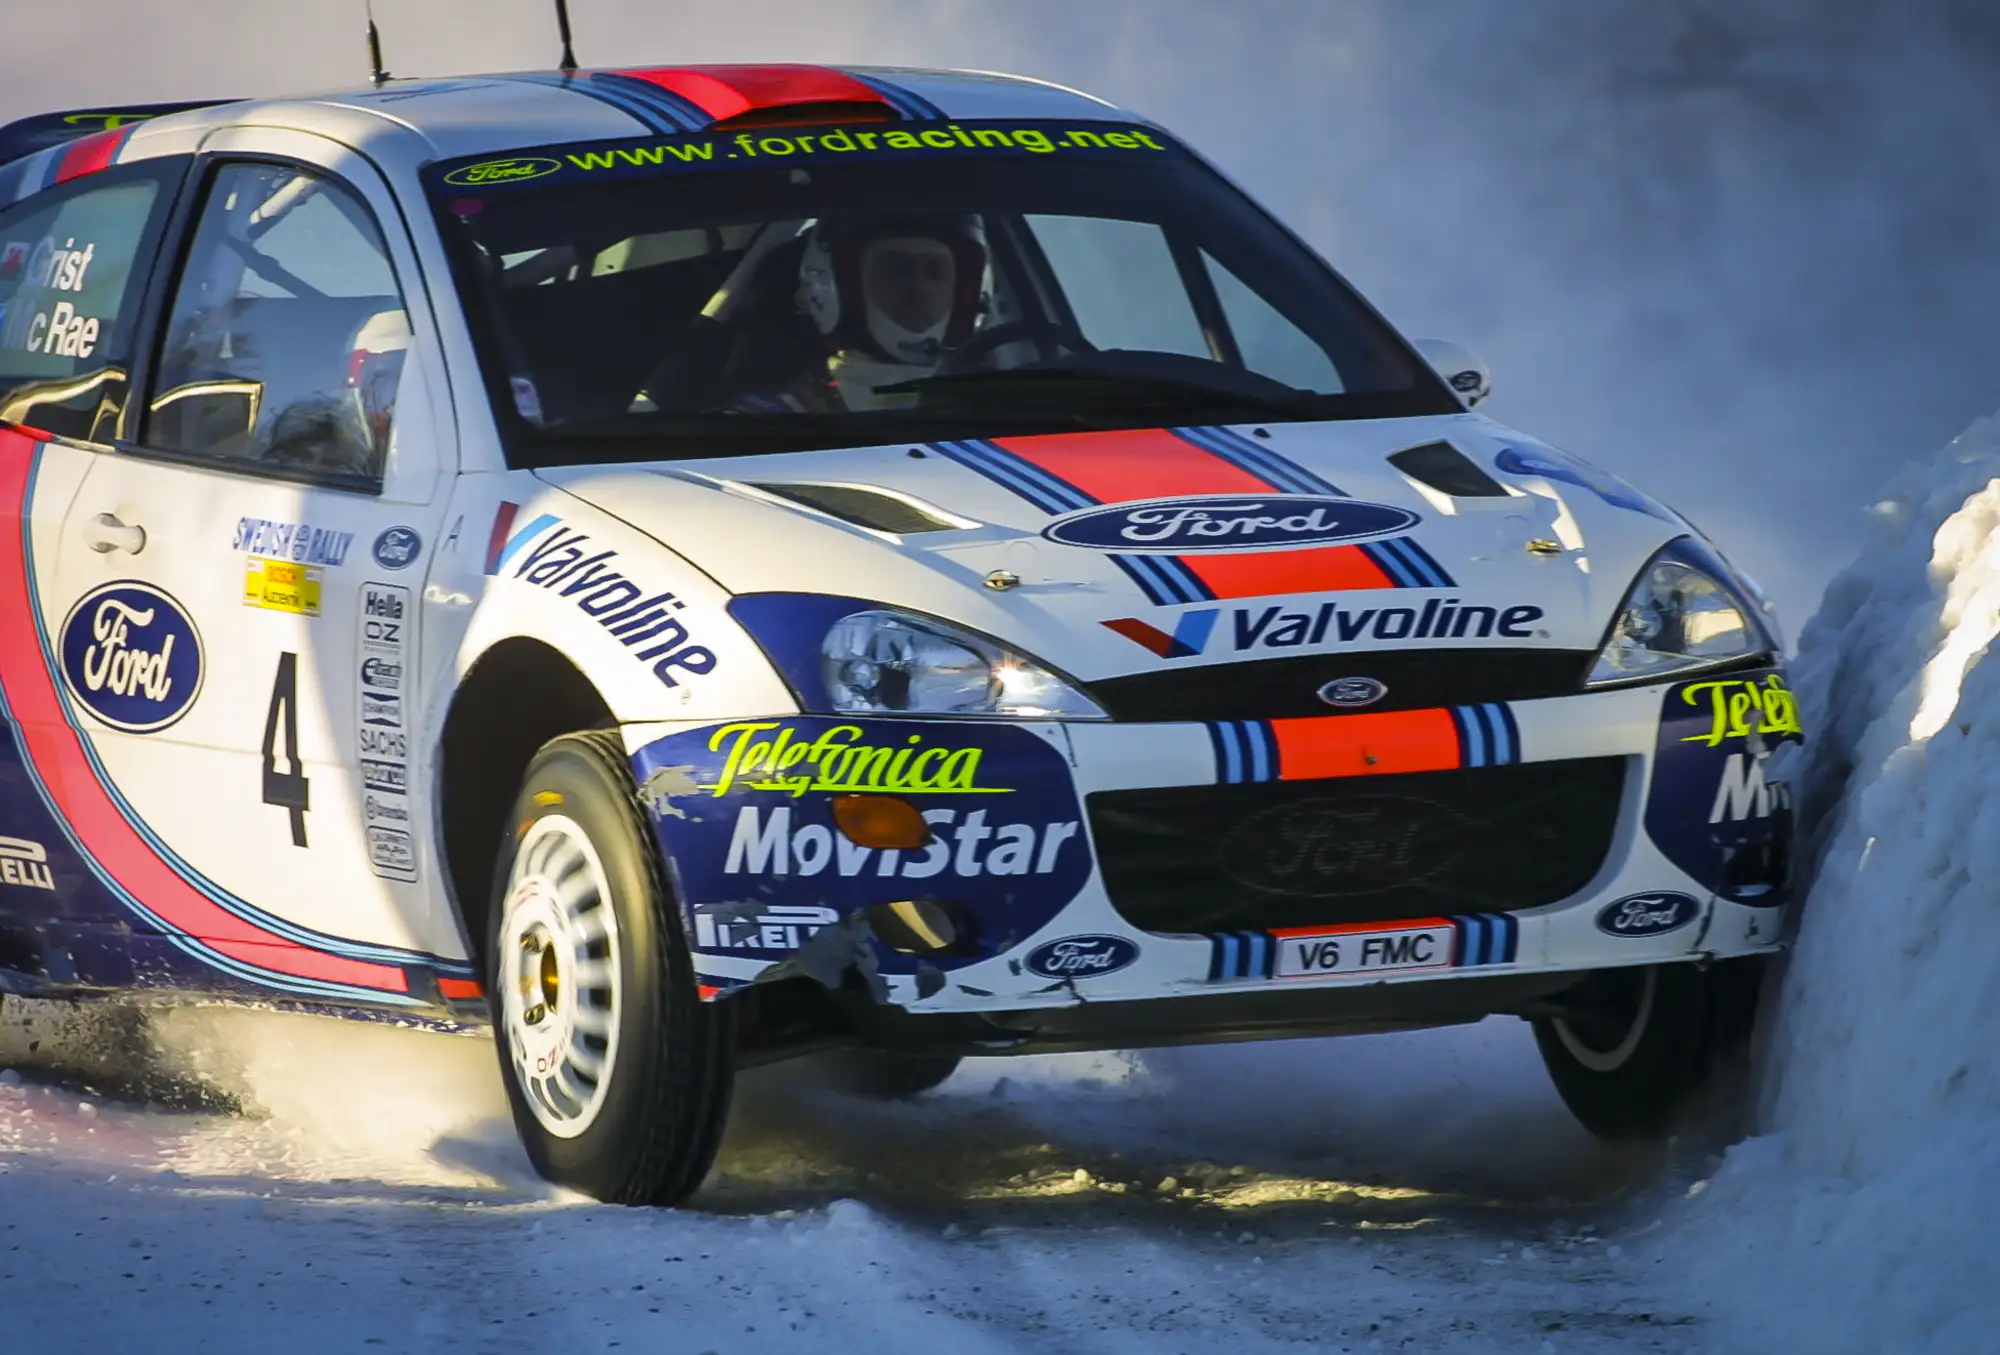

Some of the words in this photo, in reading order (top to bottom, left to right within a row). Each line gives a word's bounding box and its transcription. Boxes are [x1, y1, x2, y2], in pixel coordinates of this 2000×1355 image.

[466, 162, 537, 182] Ford
[1121, 503, 1339, 541] Ford
[514, 526, 717, 688] Valvoline
[1233, 599, 1544, 650] Valvoline
[365, 621, 401, 642] OZ
[84, 599, 175, 702] Ford
[262, 651, 310, 848] 4
[1614, 898, 1680, 929] Ford
[1045, 942, 1115, 971] Ford
[1298, 941, 1340, 970] V6
[1360, 933, 1434, 967] FMC
